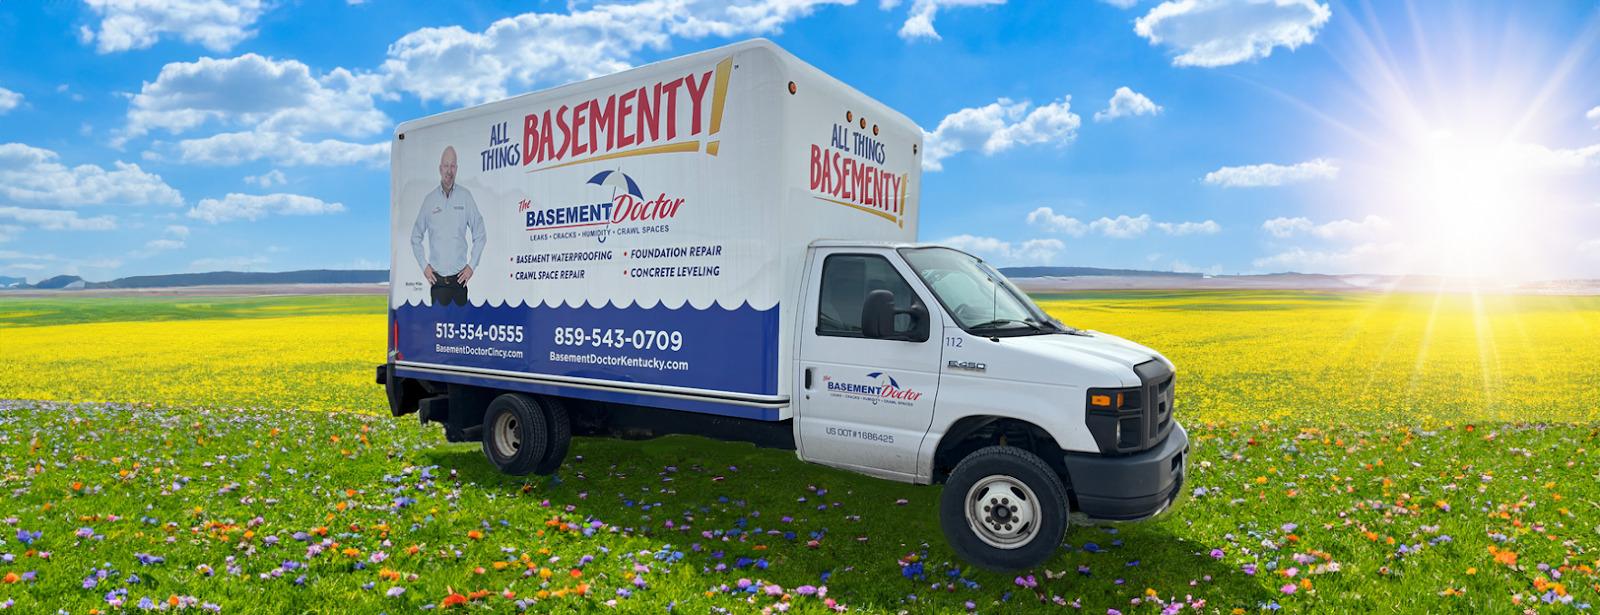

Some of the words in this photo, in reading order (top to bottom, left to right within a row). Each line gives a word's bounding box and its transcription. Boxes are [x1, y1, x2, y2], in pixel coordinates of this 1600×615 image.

[522, 54, 734, 167] BASEMENTY!
[489, 121, 510, 147] ALL
[831, 123, 850, 152] ALL
[853, 131, 886, 165] THINGS
[481, 143, 521, 172] THINGS
[810, 143, 908, 230] BASEMENTY!
[518, 199, 532, 213] The
[525, 202, 613, 227] BASEMENT
[611, 192, 685, 224] Doctor
[529, 233, 548, 241] LEAKS
[553, 231, 577, 240] CRACKS
[582, 228, 611, 238] HUMIDITY
[617, 227, 640, 236] CRAWL
[642, 224, 670, 234] SPACES
[516, 253, 550, 264] BASEMENT
[551, 250, 613, 263] WATERPROOFING
[630, 246, 688, 259] FOUNDATION
[689, 245, 722, 257] REPAIR
[515, 270, 537, 281] CRAWL
[538, 270, 559, 280] SPACE
[560, 269, 585, 280] REPAIR
[630, 267, 676, 278] CONCRETE
[677, 265, 720, 277] LEVELING
[435, 322, 524, 343] 513-554-0555
[554, 326, 683, 351] 859-543-0709
[945, 336, 963, 348] 112
[435, 343, 524, 359] BasementDoctorCincy.com
[549, 351, 689, 371] BasementDoctorKentucky.com
[827, 381, 882, 395] BASEMENT
[881, 384, 923, 401] Doctor
[825, 427, 837, 435] US
